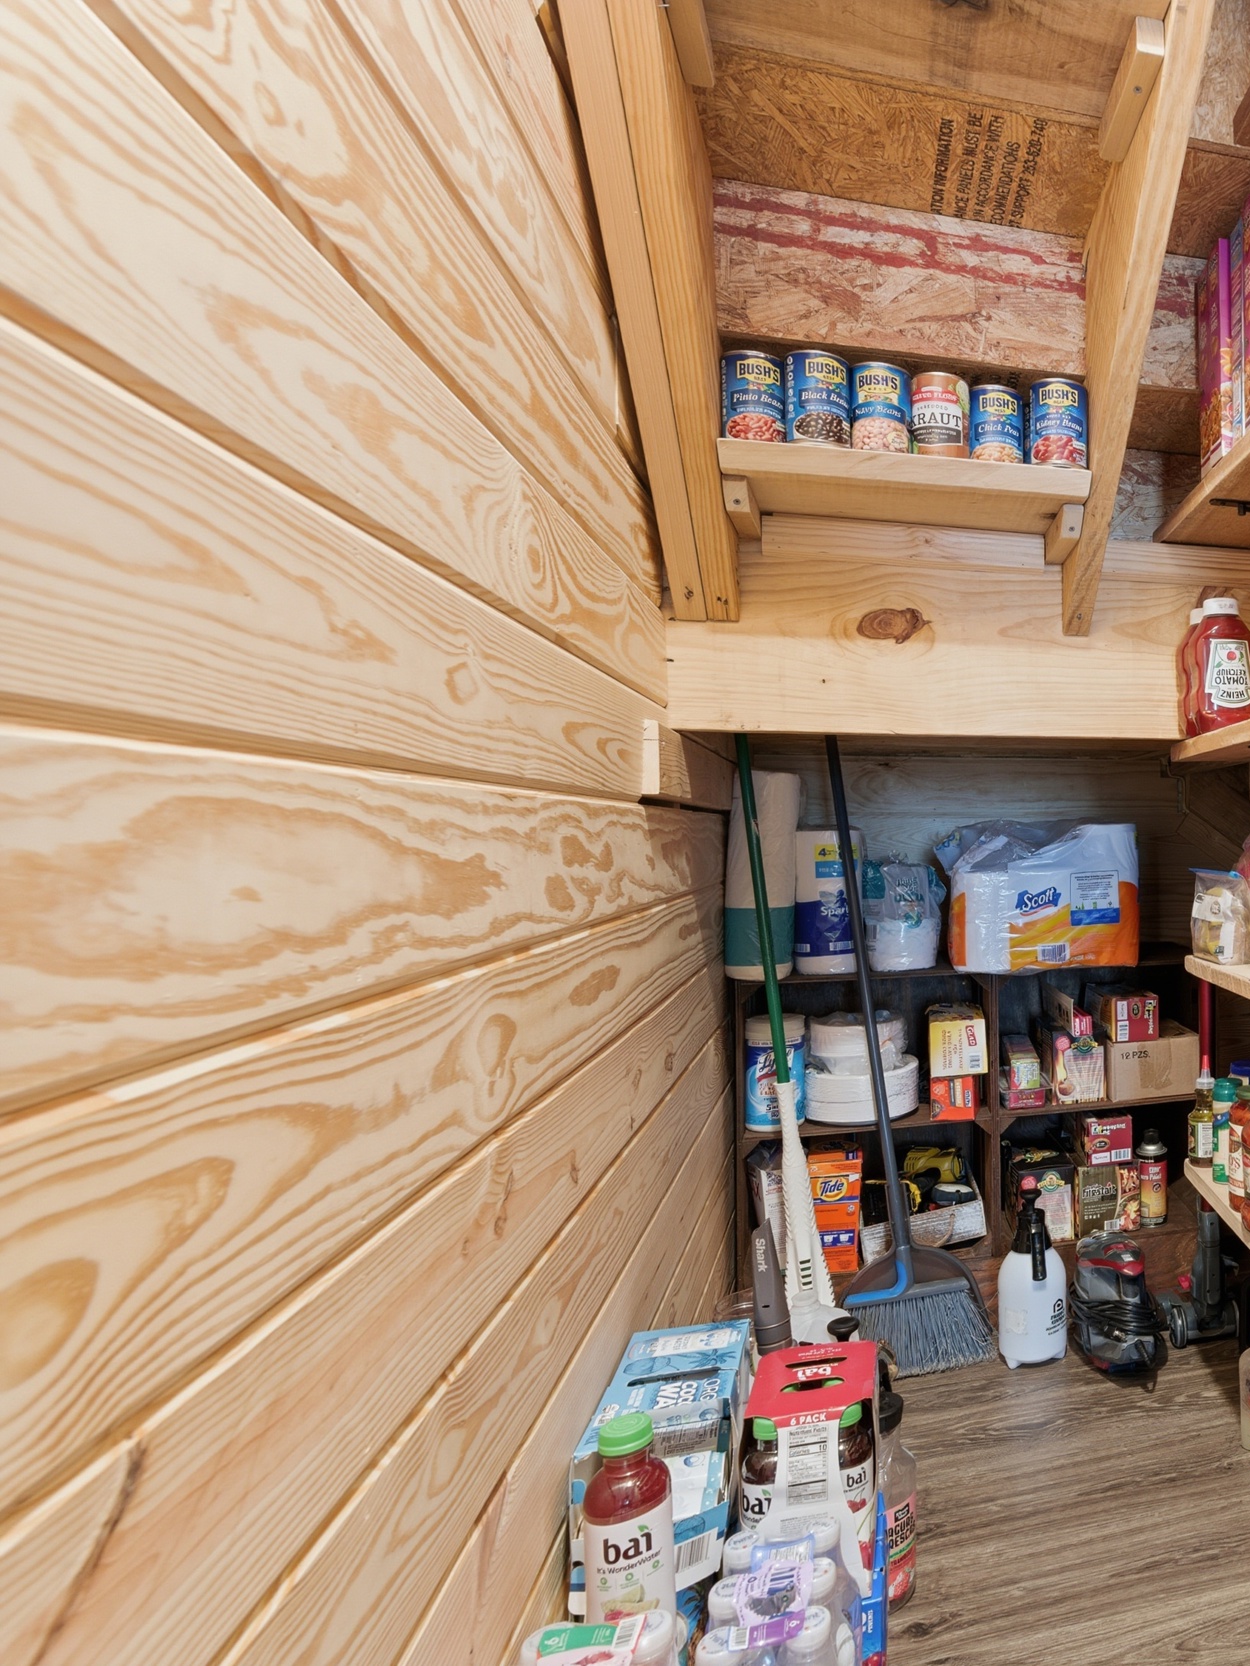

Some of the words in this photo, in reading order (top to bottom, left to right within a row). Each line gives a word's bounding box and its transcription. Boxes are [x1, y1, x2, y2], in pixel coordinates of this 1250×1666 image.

[986, 114, 1005, 143] WITH
[934, 117, 954, 187] INFORMATION
[956, 160, 975, 195] PANELS
[967, 111, 983, 128] BE
[1010, 177, 1031, 219] SUPPORT
[738, 362, 780, 385] BUSH'S
[806, 361, 846, 382] BUSH'S
[857, 373, 899, 390] BUSH'S
[733, 392, 759, 402] Pinto
[801, 391, 828, 401] Black
[1040, 387, 1077, 404] BUSH'S
[855, 406, 874, 416] Navy
[875, 405, 902, 418] Beans
[981, 396, 1017, 414] BUSH'S
[911, 411, 962, 429] KRAUT
[977, 423, 1003, 434] Chick
[1036, 418, 1060, 431] Kidney
[1214, 676, 1248, 686] TOMATO
[1215, 668, 1246, 676] KETCHUP
[1220, 689, 1246, 699] HEINZ
[1022, 886, 1055, 911] Scott
[965, 1025, 977, 1047] GLAD
[1121, 1051, 1130, 1060] 12
[1132, 1050, 1151, 1060] PZS.
[820, 1178, 845, 1197] Tide
[755, 1238, 769, 1273] Shark
[796, 1365, 832, 1381] bai
[790, 1417, 797, 1426] 6
[799, 1413, 828, 1425] PACK
[819, 1444, 828, 1452] 10
[846, 1467, 867, 1488] bai
[603, 1526, 654, 1565] bai
[607, 1547, 663, 1575] WonderWater
